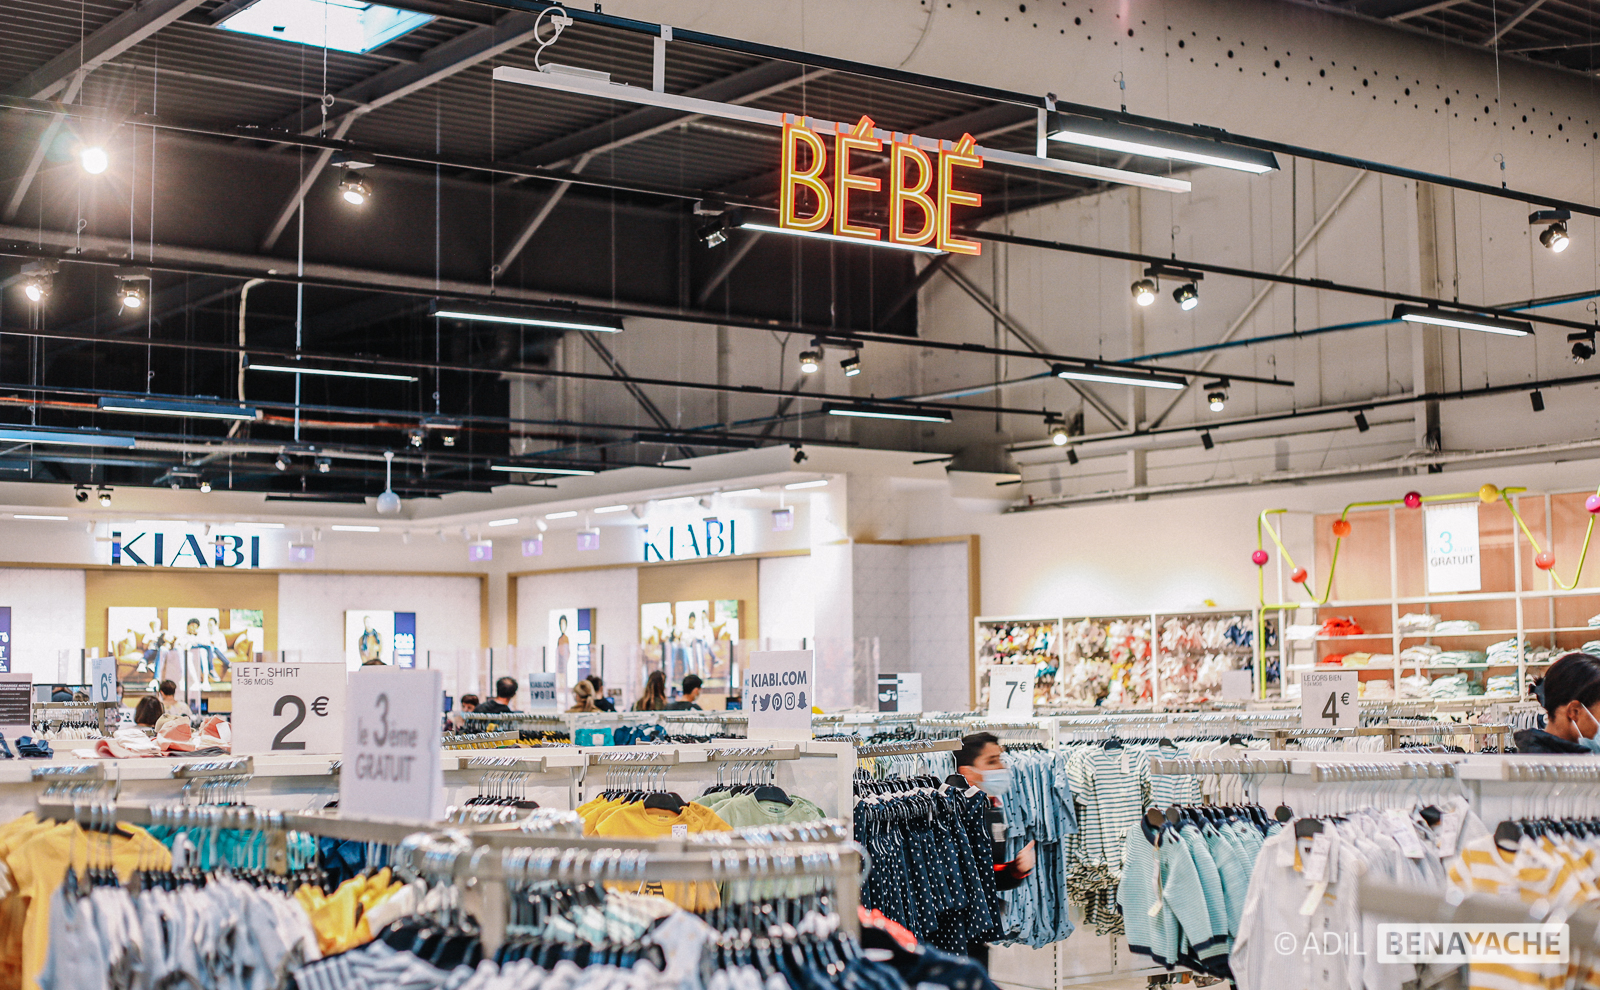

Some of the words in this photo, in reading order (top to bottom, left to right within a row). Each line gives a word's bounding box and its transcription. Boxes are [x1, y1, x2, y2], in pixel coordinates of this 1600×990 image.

[780, 113, 983, 255] BÉBÉ
[111, 531, 260, 568] KIABI
[643, 520, 735, 561] KIABI
[1430, 555, 1475, 567] GRATUIT
[237, 668, 250, 677] LE
[267, 668, 300, 678] SHIRT
[751, 671, 807, 687] KIABI.COM
[355, 753, 416, 782] GRATUIT
